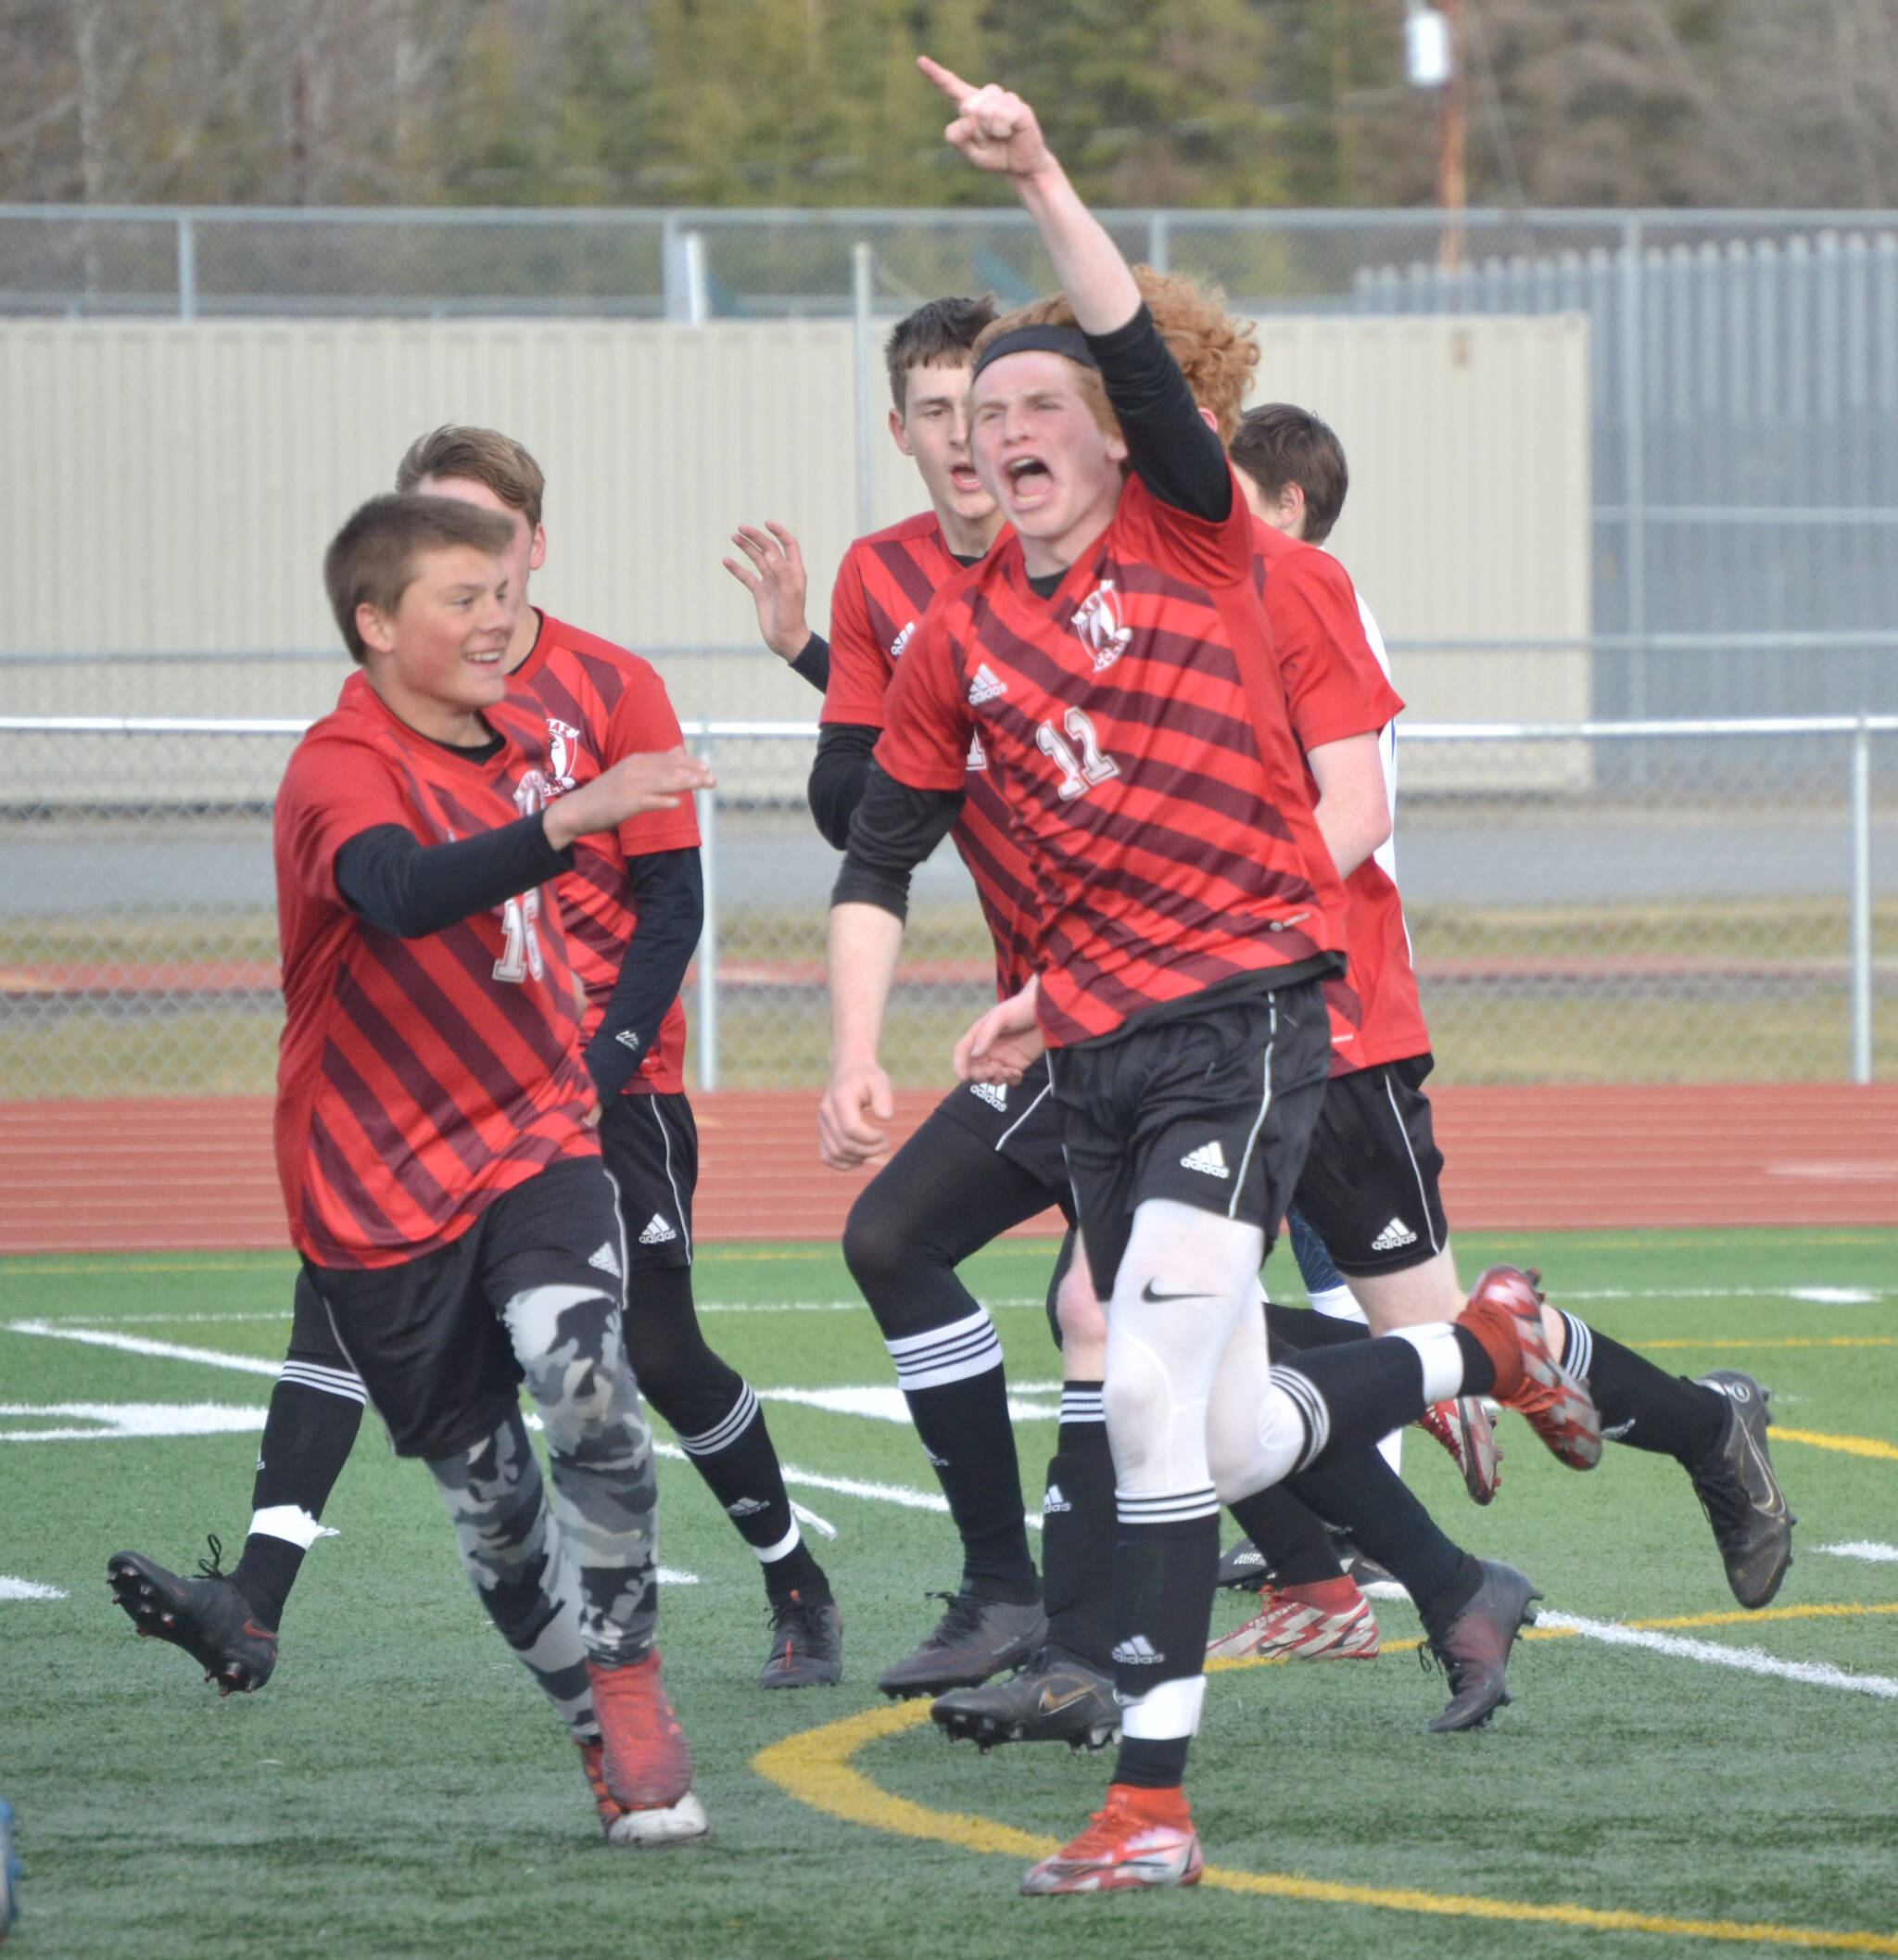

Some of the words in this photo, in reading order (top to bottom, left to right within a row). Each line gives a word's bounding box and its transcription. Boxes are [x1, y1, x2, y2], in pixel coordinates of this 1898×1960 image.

[968, 681, 1008, 704] adidas
[969, 1083, 1007, 1111] adidas
[1180, 1155, 1230, 1179] adidas
[639, 1229, 677, 1244] adidas
[1371, 1231, 1417, 1250] adidas
